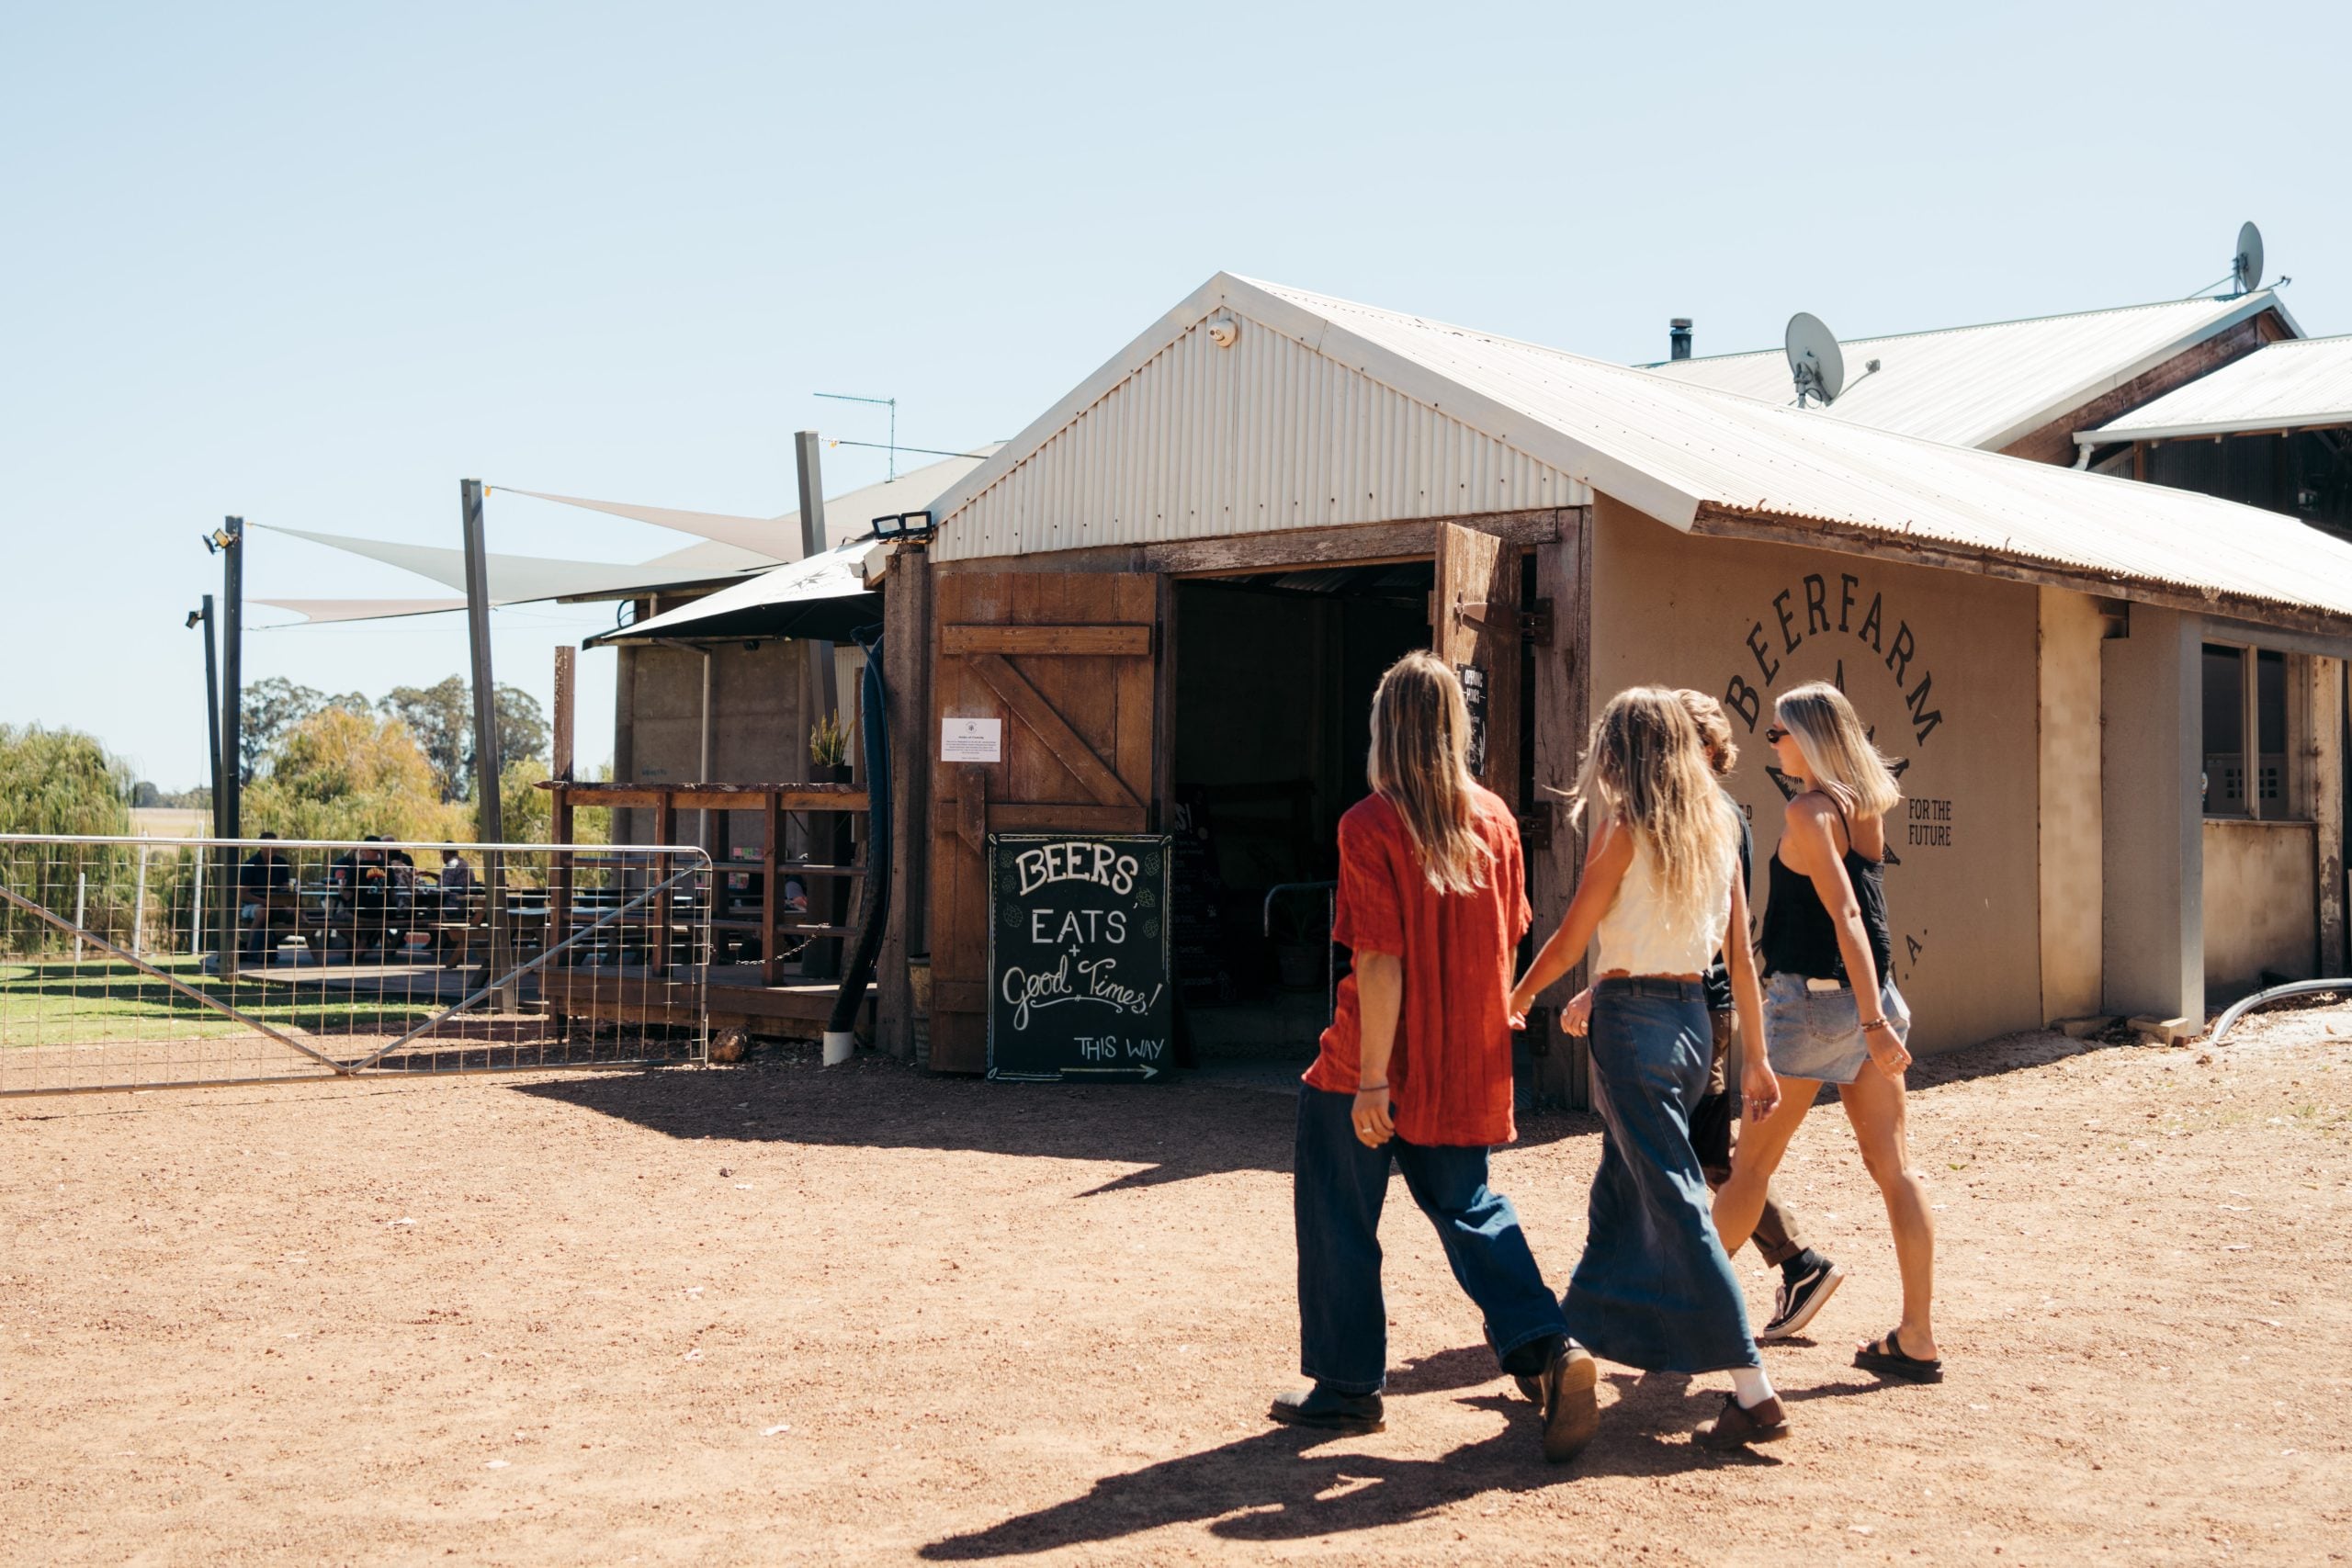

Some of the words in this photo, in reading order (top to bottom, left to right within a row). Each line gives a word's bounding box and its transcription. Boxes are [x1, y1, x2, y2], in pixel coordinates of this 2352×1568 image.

[1724, 572, 1943, 746] BEERFARM
[1908, 798, 1929, 820] FOR
[1931, 799, 1951, 821] THE
[1908, 824, 1951, 846] FUTURE
[1032, 908, 1127, 944] EATS
[1002, 954, 1072, 1031] Good
[1078, 958, 1163, 1016] Times!
[1073, 1035, 1117, 1061] THIS
[1125, 1038, 1165, 1061] WAY
